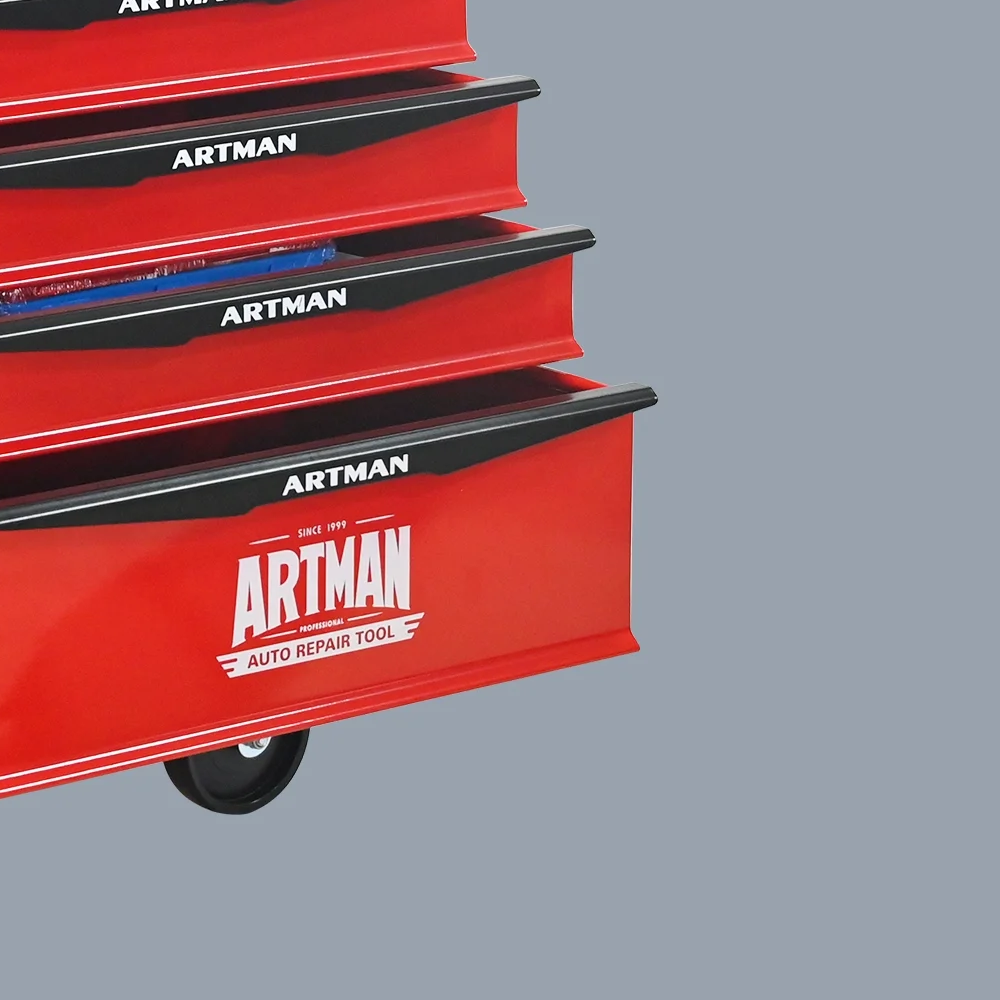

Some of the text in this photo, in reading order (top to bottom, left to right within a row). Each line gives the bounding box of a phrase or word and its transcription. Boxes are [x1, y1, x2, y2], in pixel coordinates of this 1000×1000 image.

[172, 133, 297, 169] ARTMAN
[220, 287, 347, 327] ARTMAN
[282, 454, 409, 496] ARTMAN
[298, 520, 347, 538] SINCE 1999
[231, 525, 411, 648] ARTMAN
[299, 618, 344, 633] PROFESSIONAL
[247, 625, 395, 669] AUTO REPAIR TOOL
